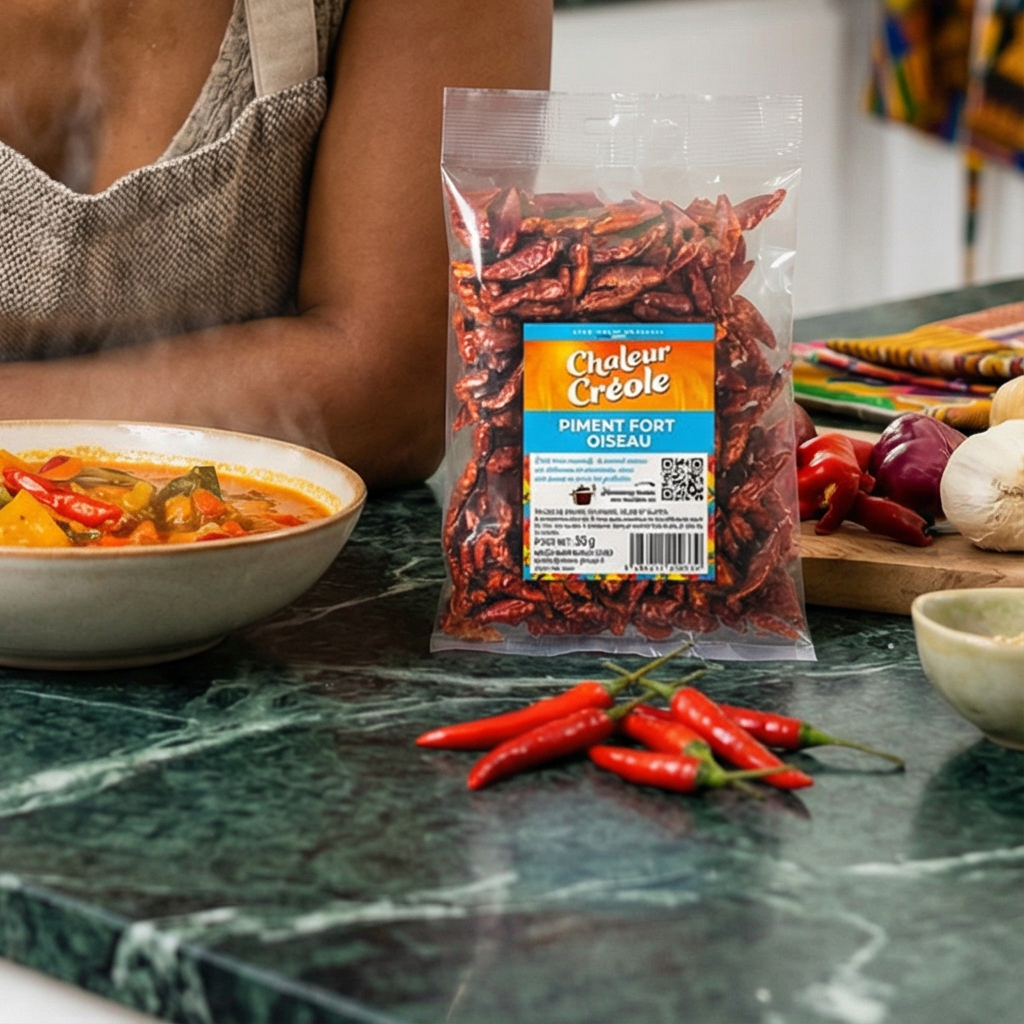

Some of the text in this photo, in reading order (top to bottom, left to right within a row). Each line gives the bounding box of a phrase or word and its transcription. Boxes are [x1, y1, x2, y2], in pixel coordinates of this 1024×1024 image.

[567, 345, 671, 377] Chaleur
[568, 368, 670, 406] Créole
[559, 419, 675, 432] PIMENT FORT
[587, 435, 651, 448] OISEAU
